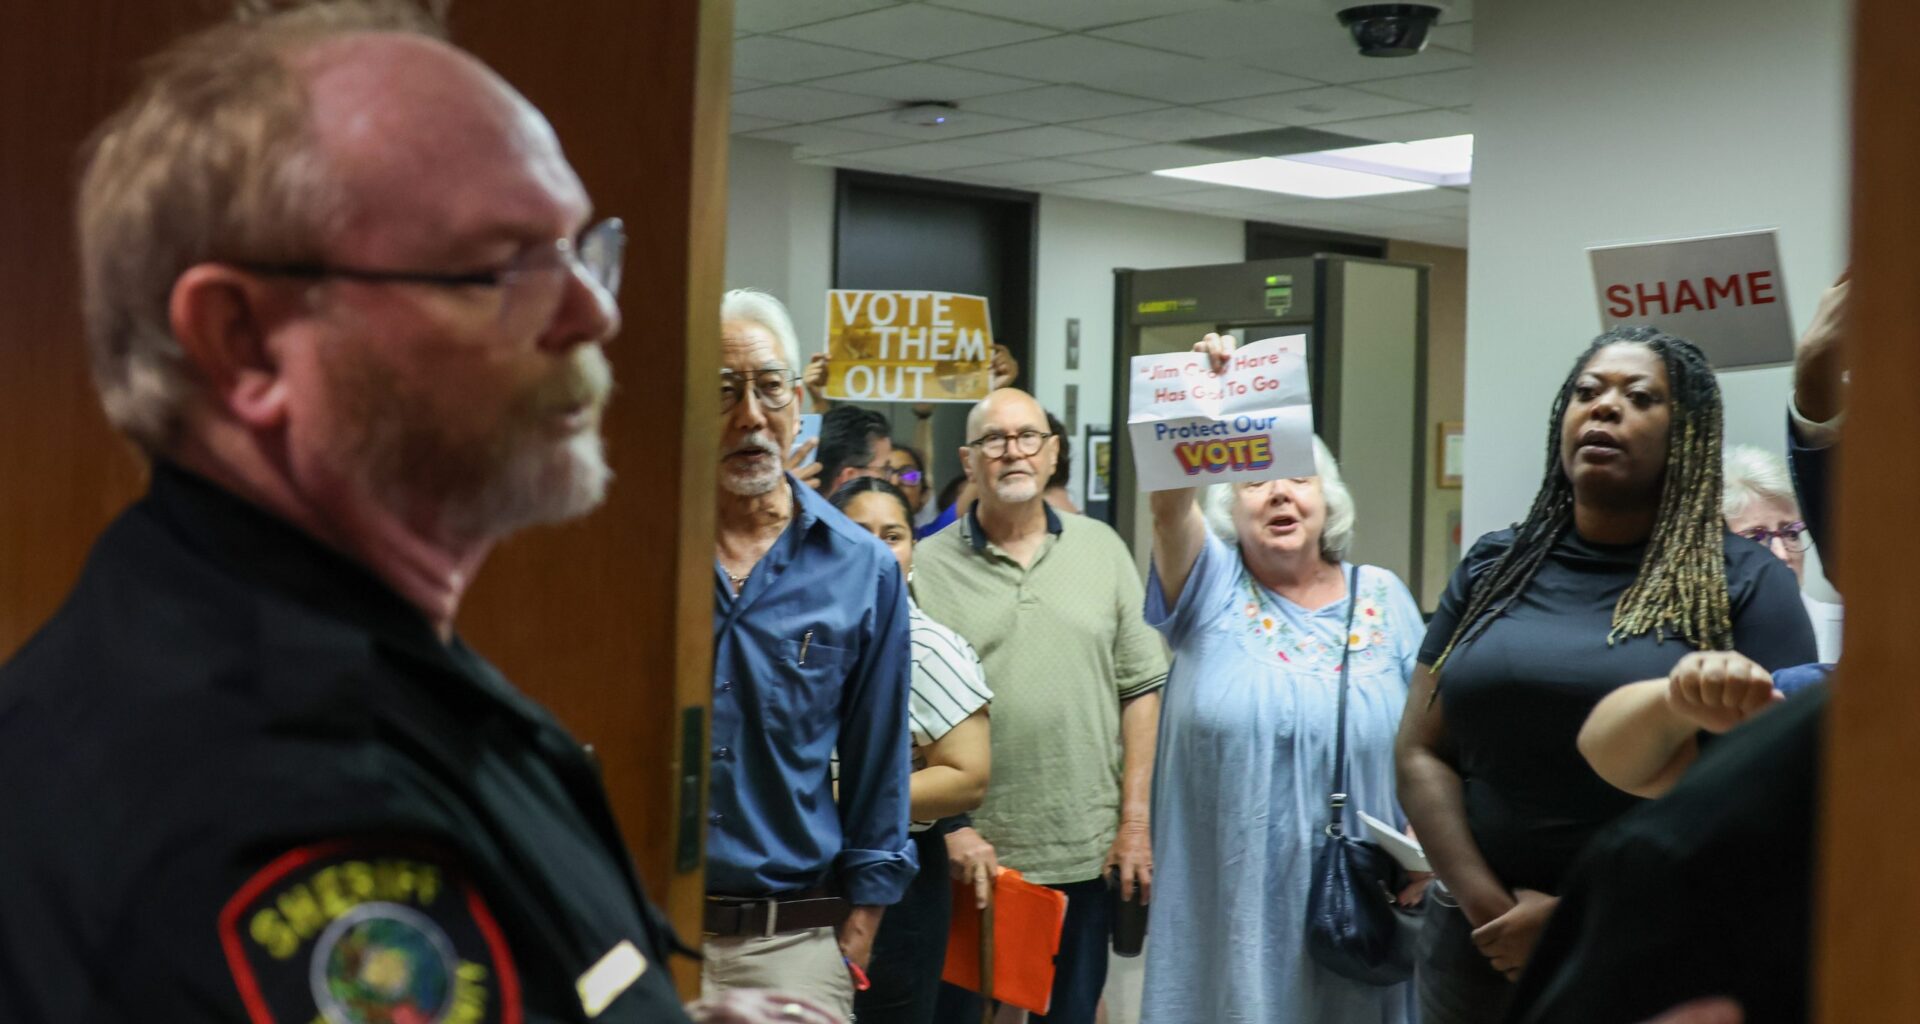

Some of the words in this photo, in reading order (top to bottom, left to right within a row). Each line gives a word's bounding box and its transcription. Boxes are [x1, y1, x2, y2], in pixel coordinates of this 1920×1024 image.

[837, 292, 954, 326] VOTE
[1606, 270, 1776, 318] SHAME
[871, 327, 986, 361] THEM
[844, 365, 934, 400] OUT
[1154, 387, 1187, 404] Has
[1227, 381, 1246, 396] To
[1252, 375, 1280, 391] Go
[1155, 421, 1229, 440] Protect
[1234, 416, 1277, 432] Our
[1174, 434, 1275, 475] VOTE
